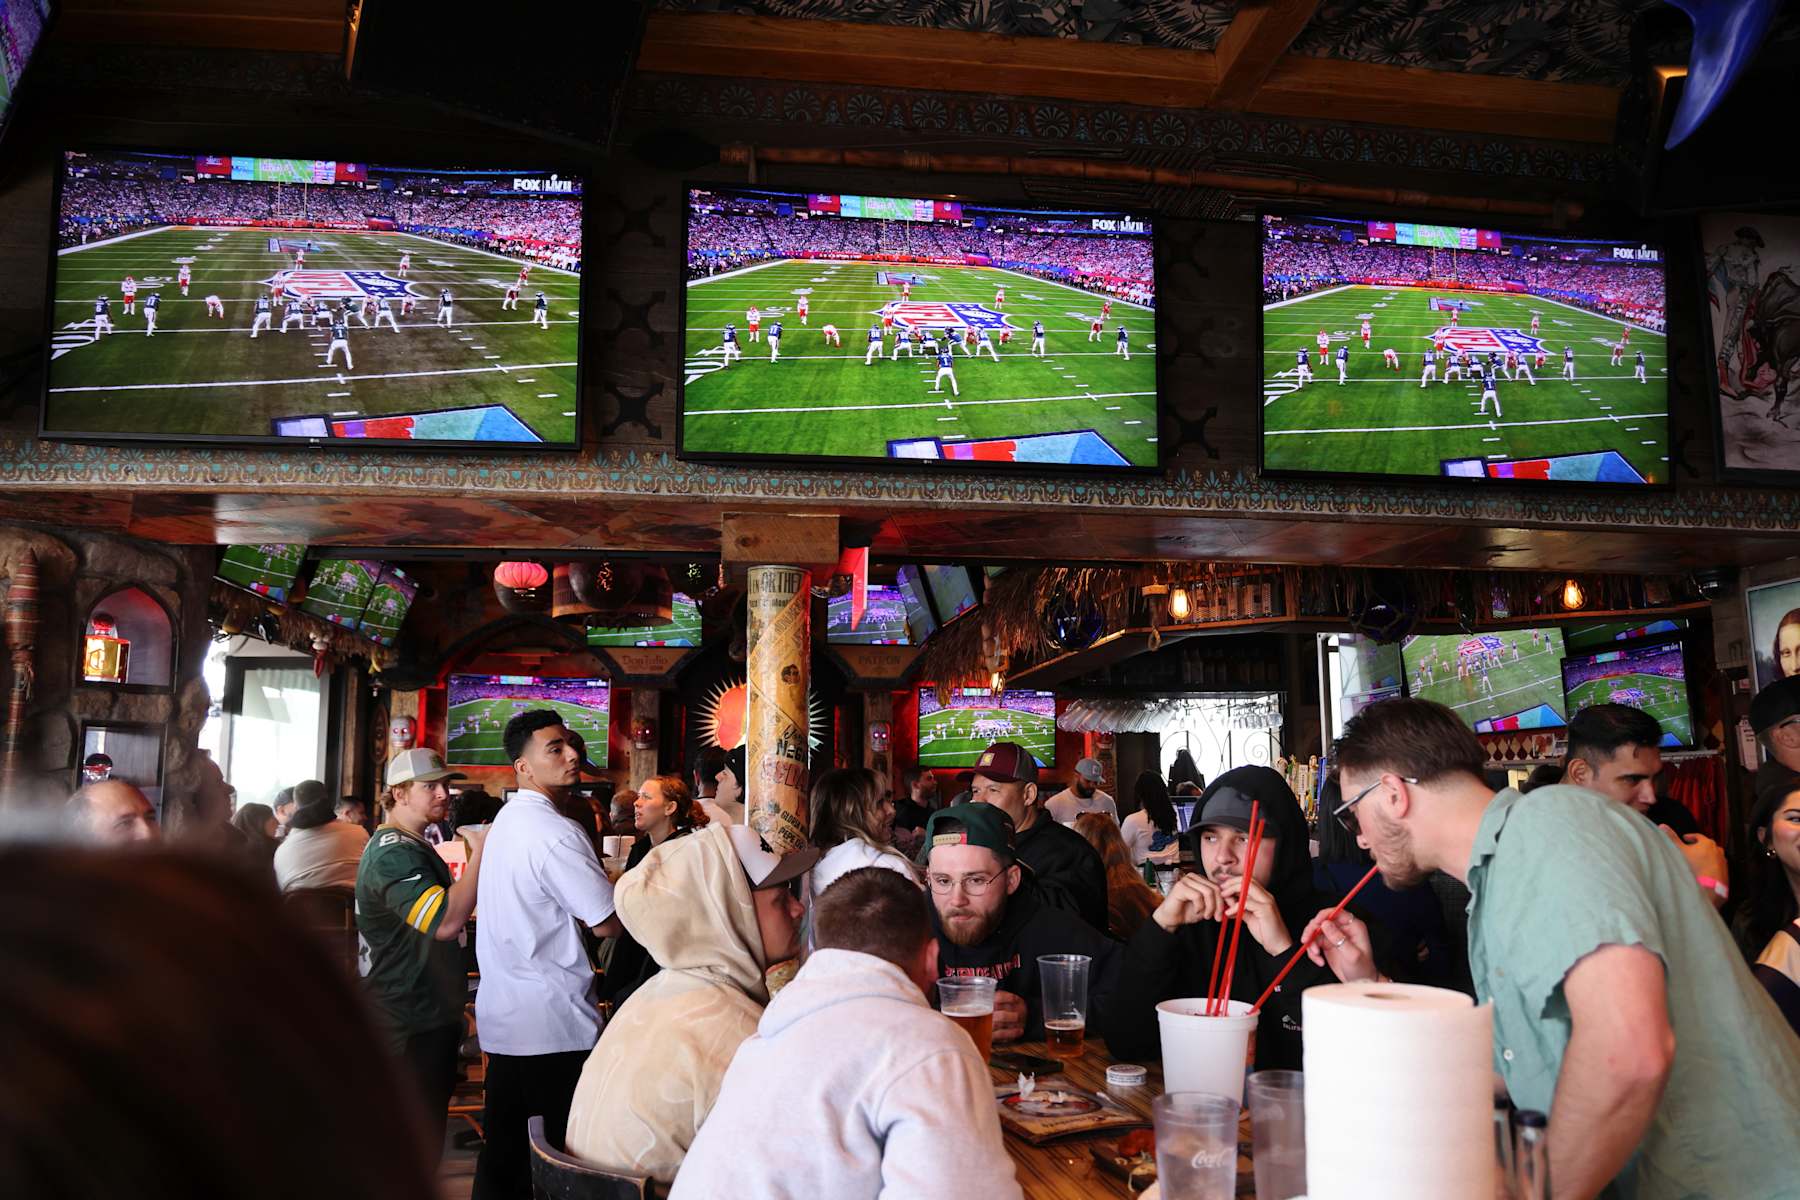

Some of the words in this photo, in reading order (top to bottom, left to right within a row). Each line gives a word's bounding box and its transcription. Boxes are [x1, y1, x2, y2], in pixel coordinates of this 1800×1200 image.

[513, 178, 540, 191] FOX
[1092, 219, 1116, 231] FOX
[1613, 247, 1634, 259] FOX
